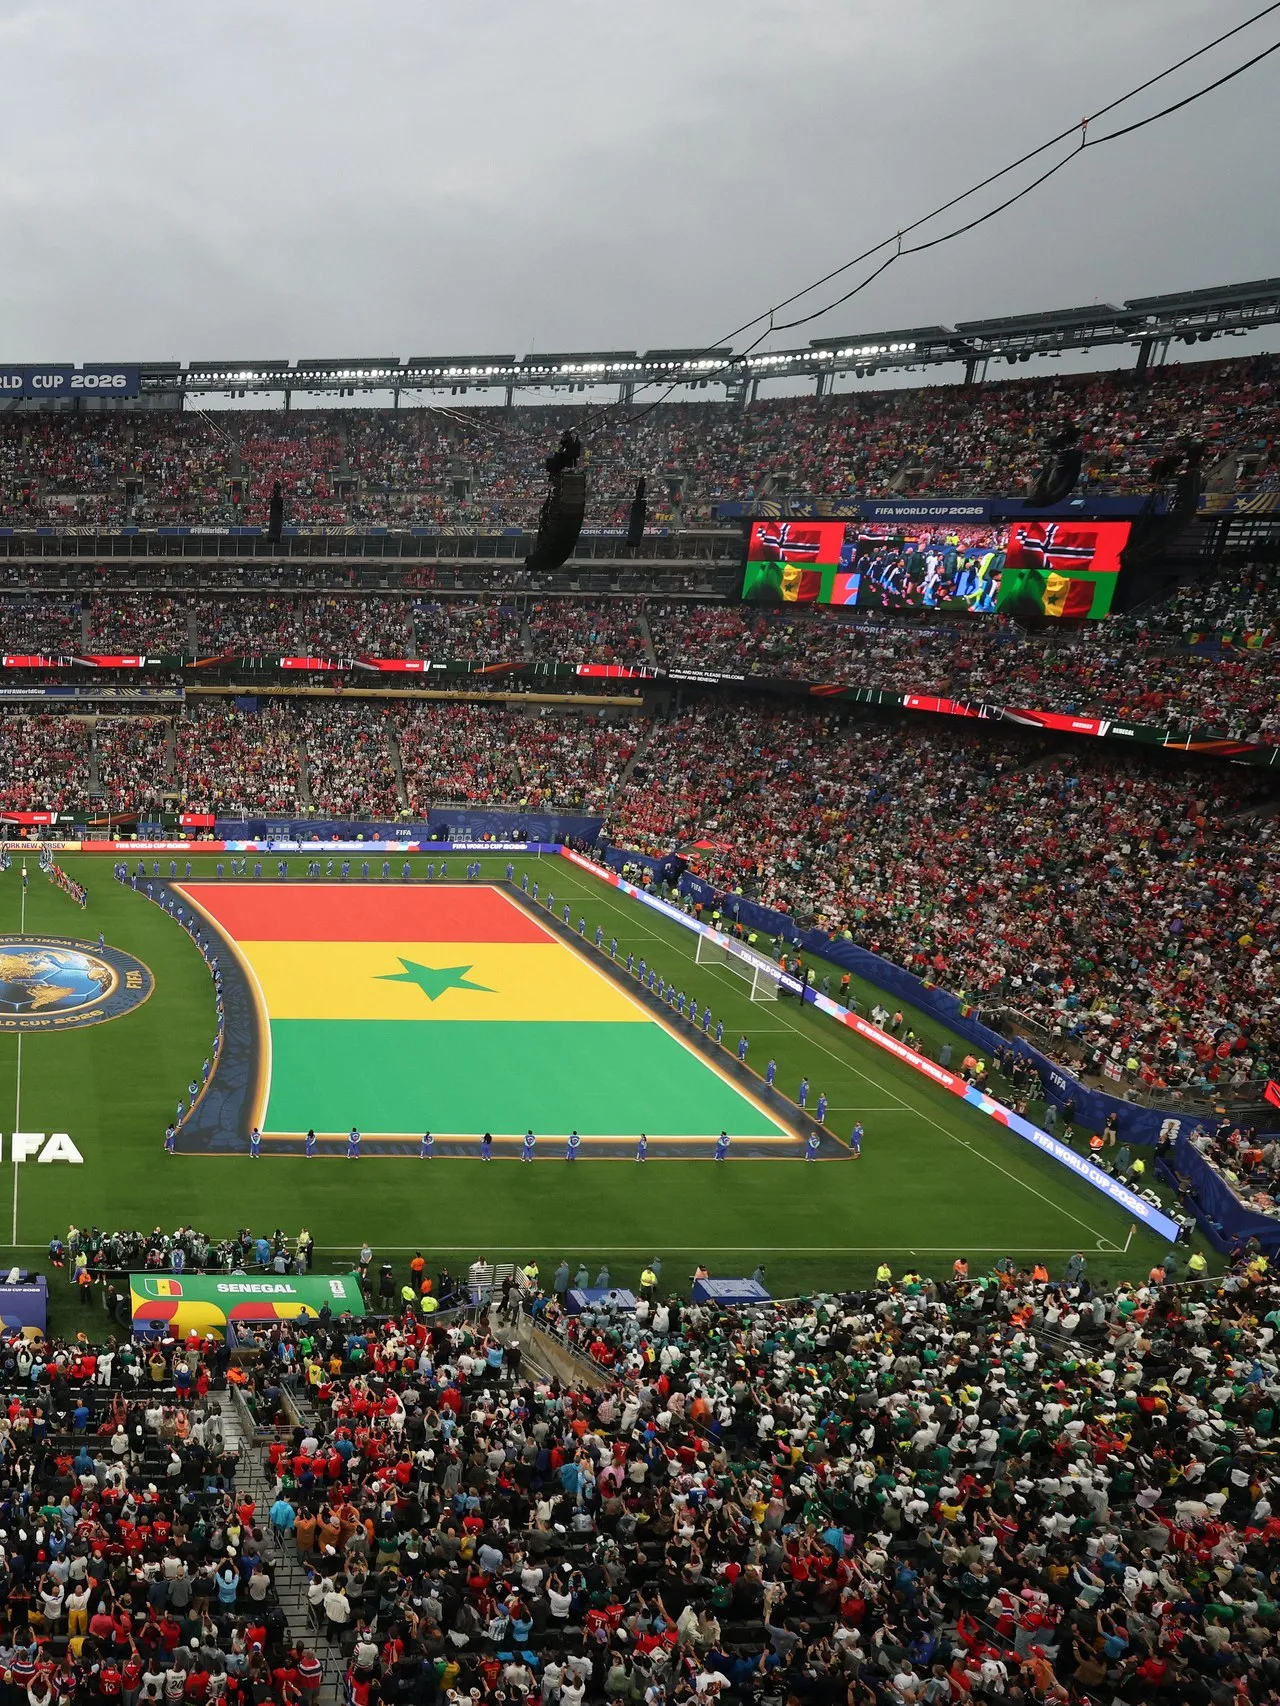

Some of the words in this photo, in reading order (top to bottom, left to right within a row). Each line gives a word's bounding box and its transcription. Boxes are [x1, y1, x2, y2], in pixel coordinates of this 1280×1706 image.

[32, 375, 64, 389] CUP
[70, 374, 126, 388] 2026
[929, 507, 948, 515] CUP
[949, 507, 984, 515] 2026
[690, 882, 702, 893] FIFA
[751, 958, 770, 973] WORLD
[770, 969, 782, 979] CUP
[126, 970, 143, 989] FIFA
[20, 1019, 51, 1027] CUP
[53, 1008, 104, 1025] 2026
[1050, 1071, 1066, 1091] FIFA
[1033, 1131, 1054, 1151] FIFA
[1054, 1145, 1090, 1174] WORLD
[1089, 1170, 1110, 1188] CUP
[216, 1283, 296, 1293] SENEGAL
[121, 1528, 127, 1536] 9
[141, 1533, 147, 1542] 9
[105, 1682, 114, 1692] 10
[171, 1680, 183, 1690] 20
